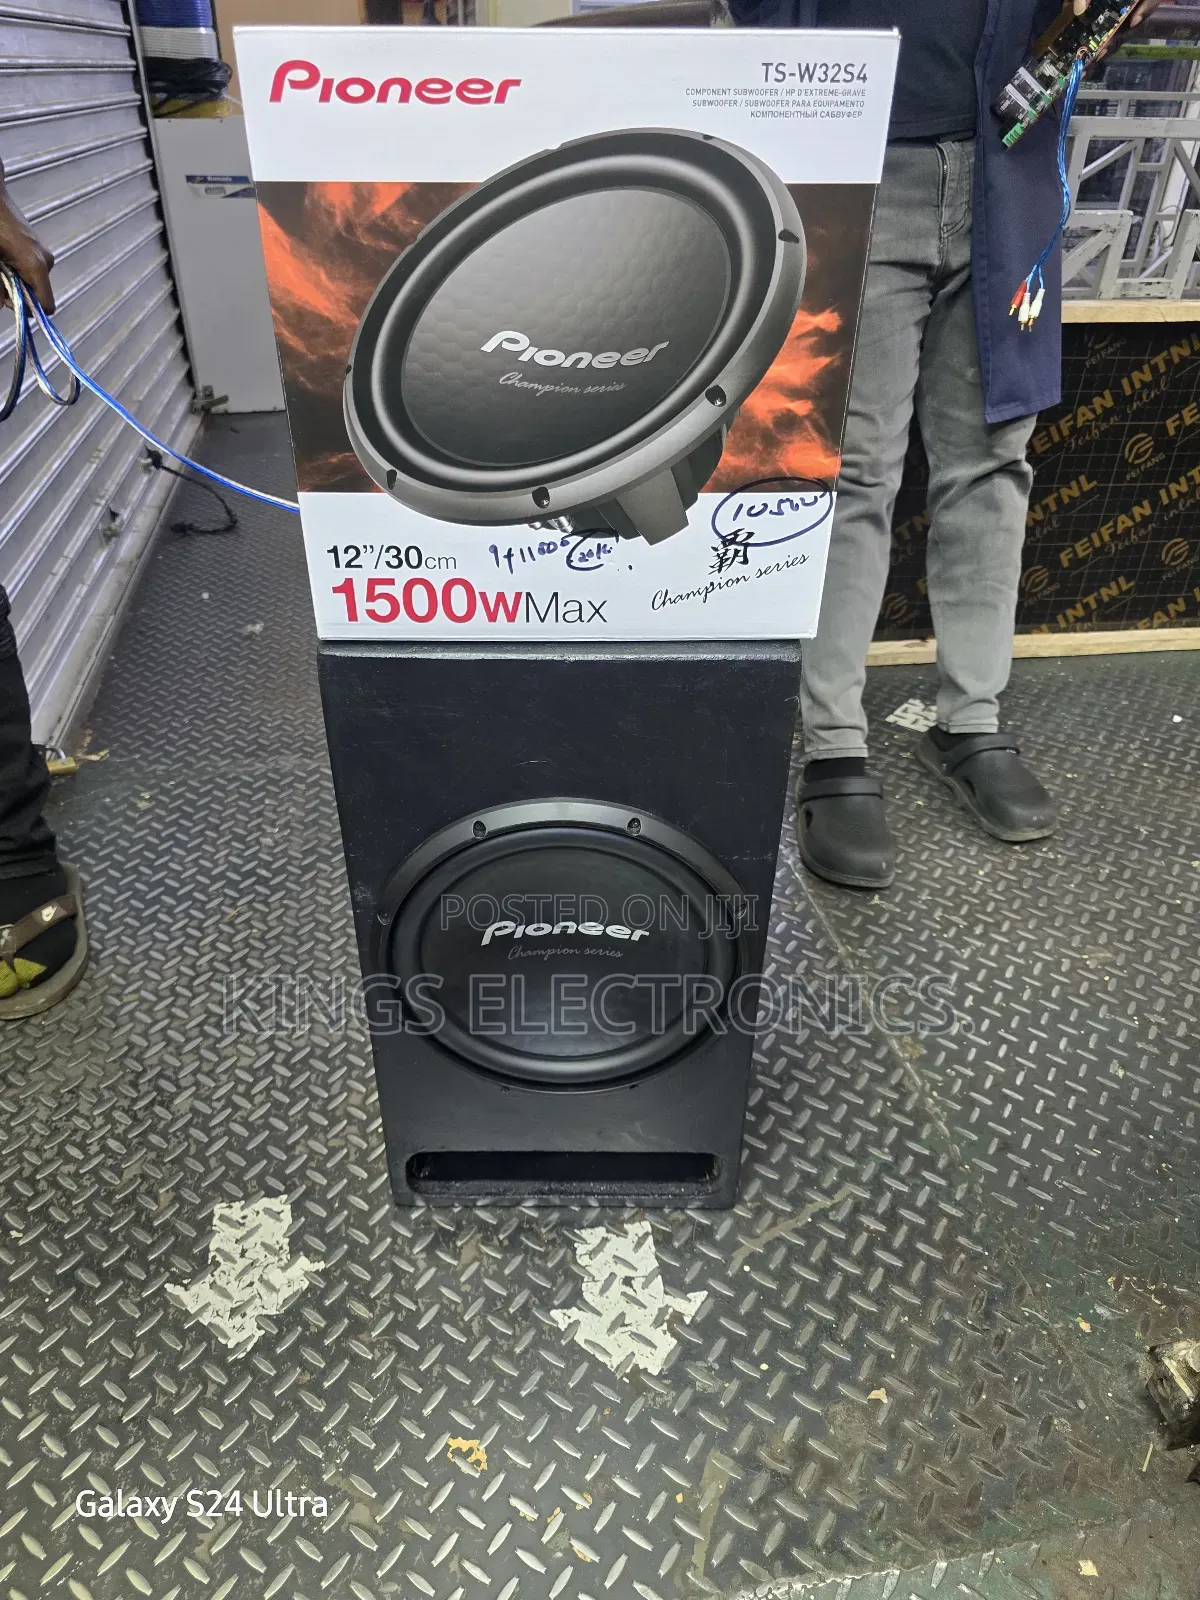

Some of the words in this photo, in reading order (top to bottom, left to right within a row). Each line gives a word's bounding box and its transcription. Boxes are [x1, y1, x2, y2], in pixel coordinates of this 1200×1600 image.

[269, 59, 522, 105] Pioneer
[761, 62, 868, 84] TS-W32S4
[685, 88, 731, 96] COMPONENT
[733, 88, 779, 96] SUBWOOFER
[785, 89, 796, 97] HP
[797, 88, 866, 97] D'EXTREME-GRAVE
[692, 99, 738, 107] SUBWOOFER
[744, 100, 790, 108] SUBWOOFER
[750, 110, 818, 119] КОМПОНЕНТНЫЙ
[480, 330, 670, 369] Pioneer
[499, 372, 580, 397] Champion
[582, 381, 627, 394] series
[1028, 389, 1114, 455] EIFAN
[1165, 402, 1200, 437] FE
[1059, 499, 1152, 568] FEIFAN
[651, 575, 751, 611] Champion
[755, 553, 810, 579] series
[1056, 575, 1136, 629] INTNL
[481, 920, 650, 946] Pioneer
[508, 944, 581, 961] Champion
[584, 946, 624, 958] series
